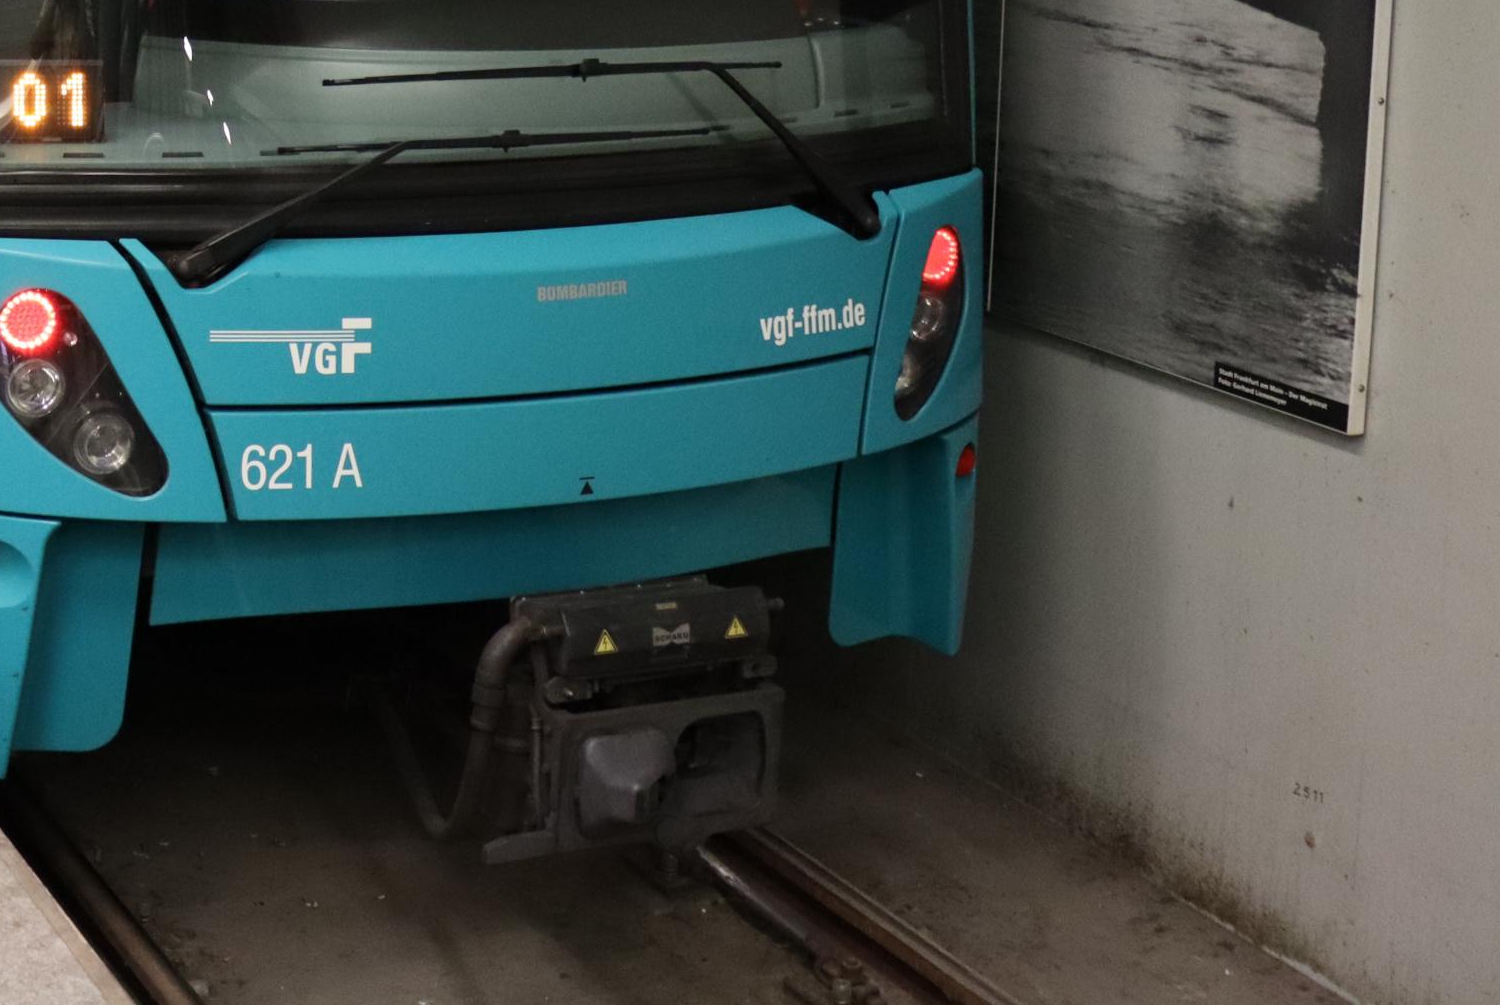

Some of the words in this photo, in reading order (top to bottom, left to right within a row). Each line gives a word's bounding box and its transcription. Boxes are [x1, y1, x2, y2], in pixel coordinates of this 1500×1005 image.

[12, 72, 86, 128] 01
[536, 280, 628, 302] BOMBARDIER
[288, 317, 373, 375] VGF
[759, 299, 866, 347] vgf-ffm.de
[240, 444, 314, 491] 621
[332, 442, 364, 489] A
